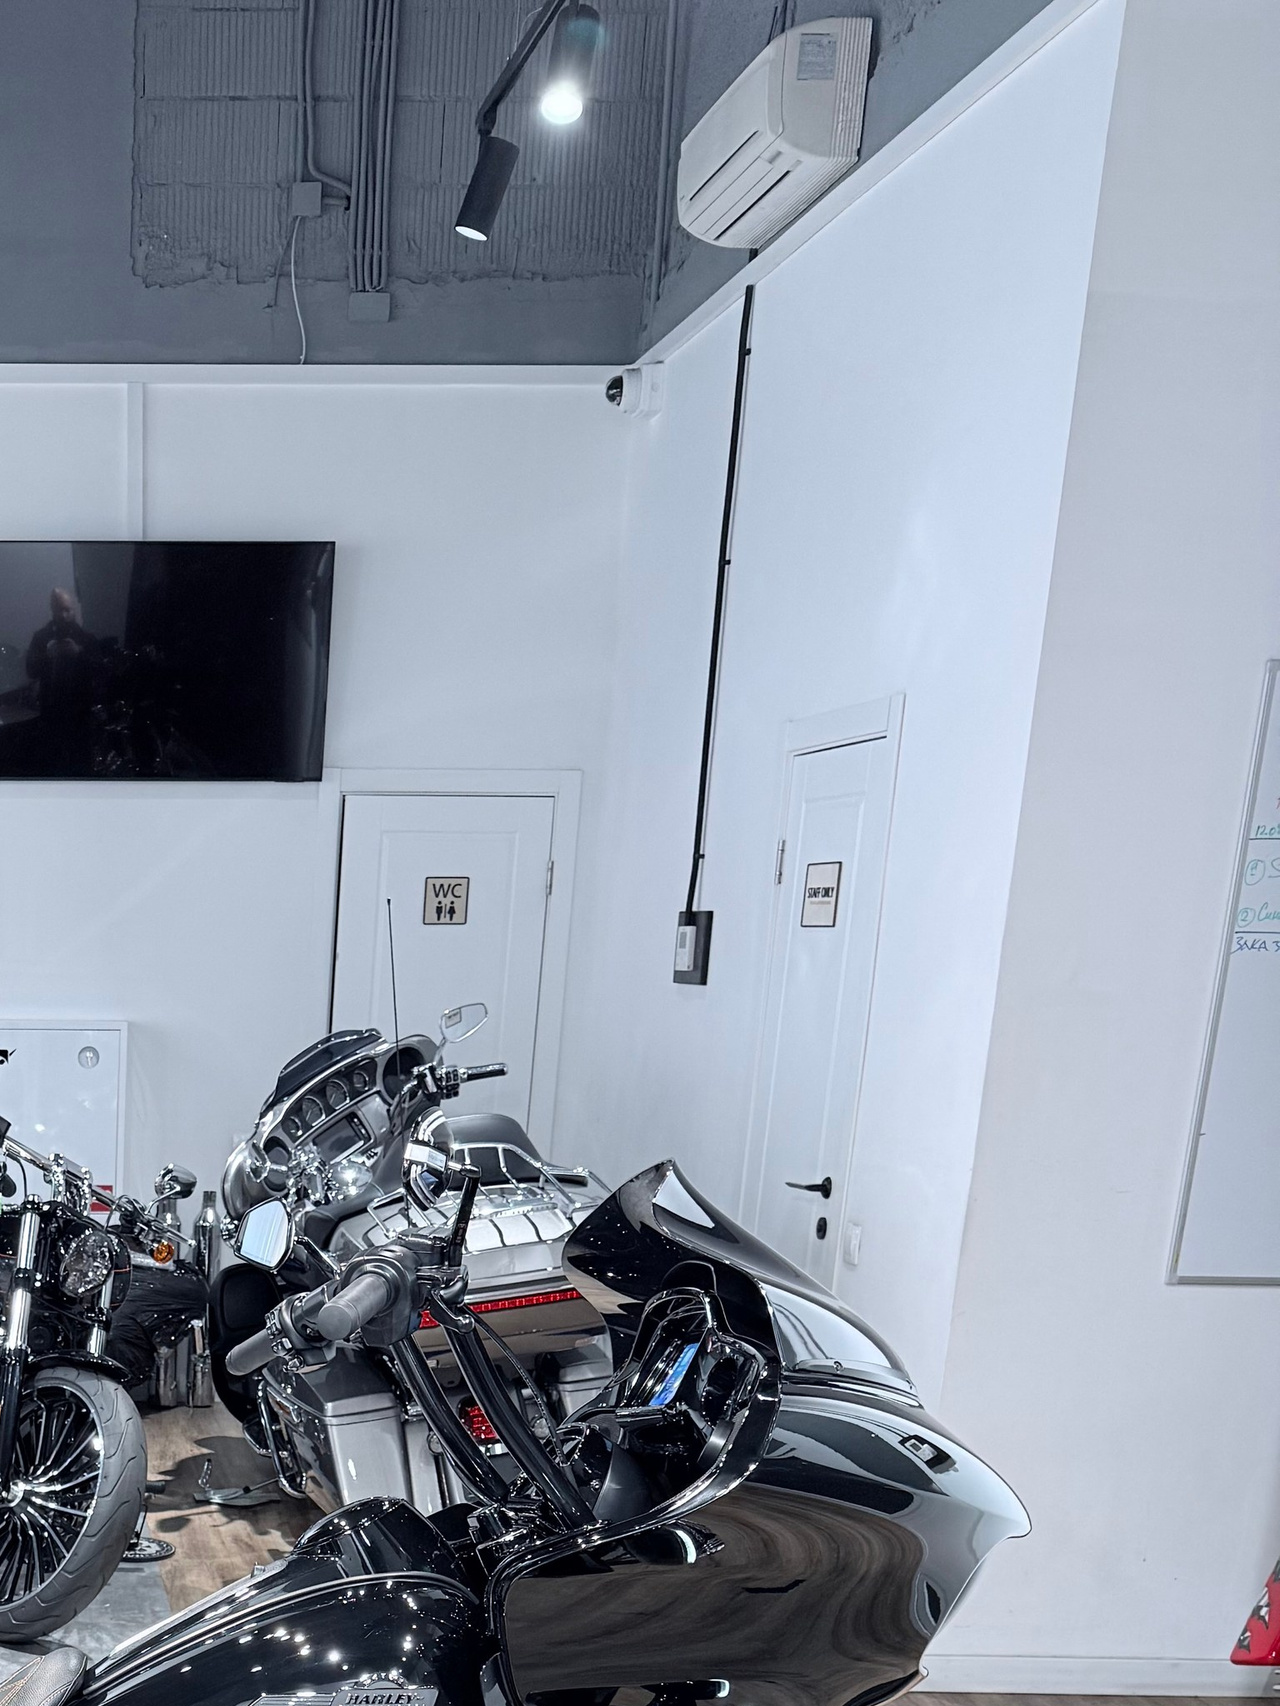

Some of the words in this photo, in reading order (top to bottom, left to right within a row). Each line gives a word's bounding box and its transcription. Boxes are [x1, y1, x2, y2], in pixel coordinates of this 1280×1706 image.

[432, 883, 462, 898] WC
[807, 887, 821, 898] STAFF
[821, 886, 835, 898] ONLY
